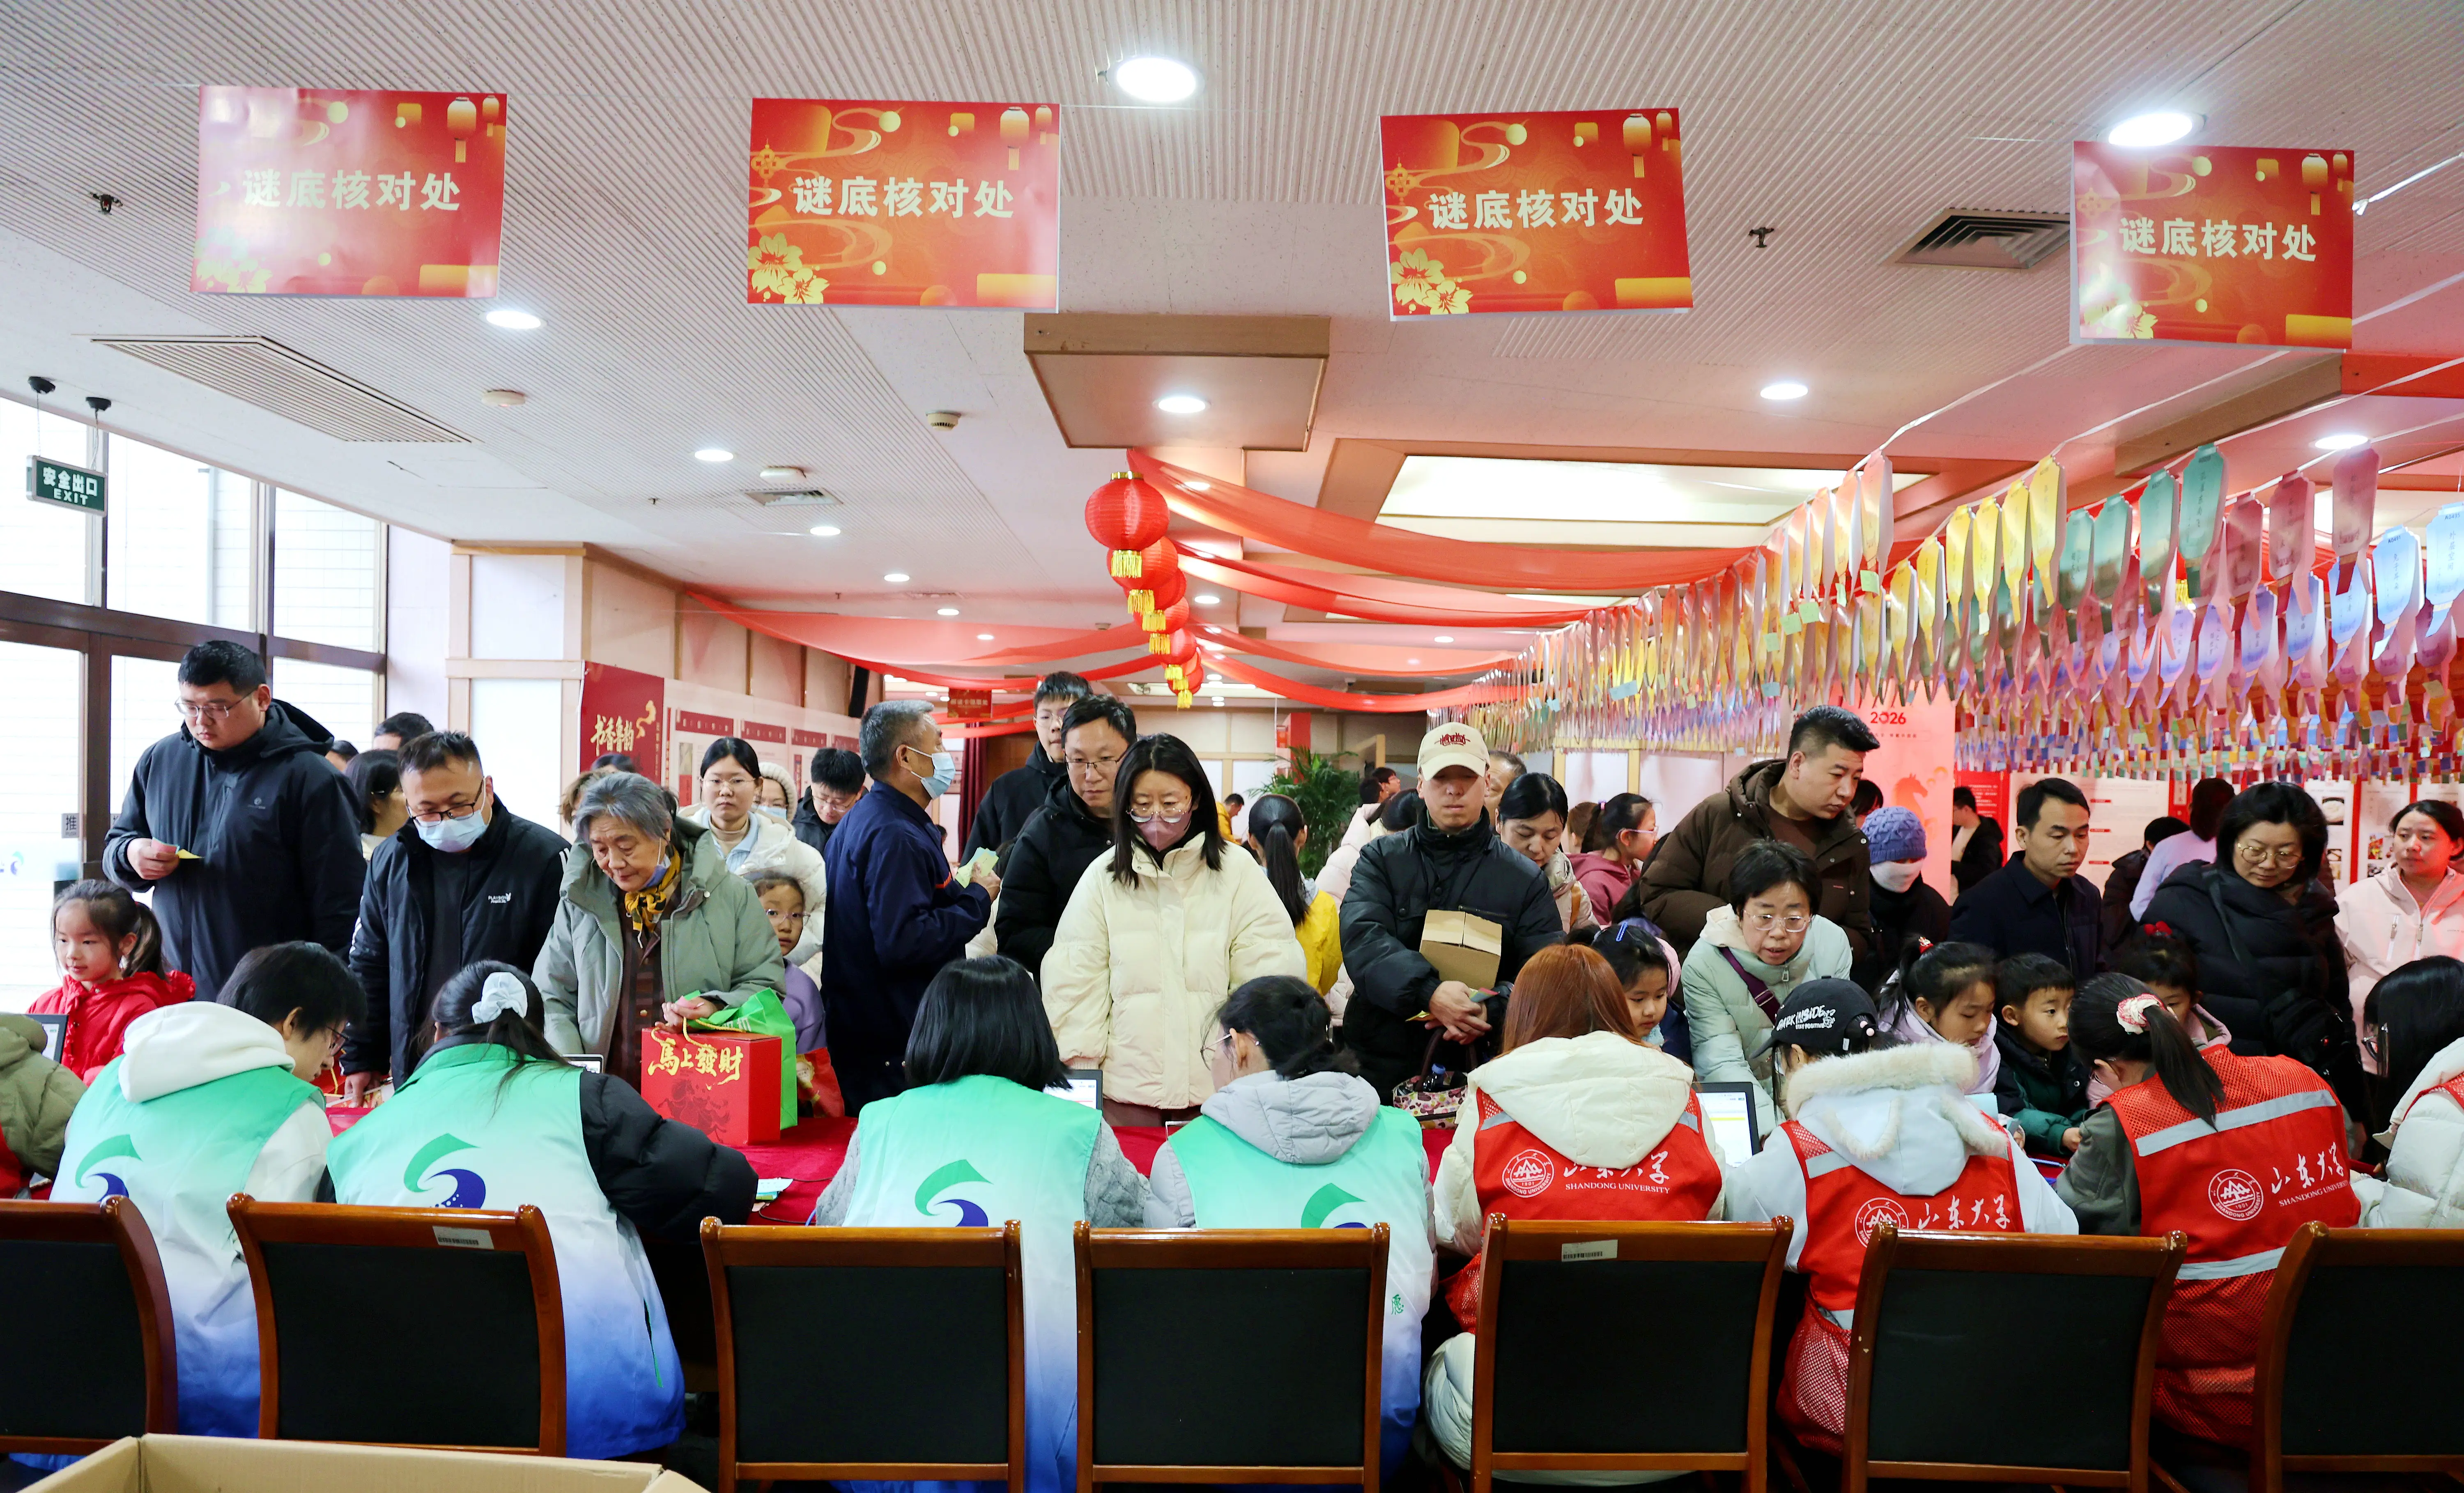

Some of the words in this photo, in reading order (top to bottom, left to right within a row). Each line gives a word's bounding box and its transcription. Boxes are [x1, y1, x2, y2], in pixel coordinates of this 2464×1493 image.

[242, 168, 460, 211] 谜底核对处
[793, 176, 1014, 218] 谜底核对处
[1429, 188, 1643, 230] 谜底核对处
[2119, 217, 2316, 262] 谜底核对处
[43, 467, 98, 497] 安全出口
[54, 488, 88, 505] EXIT
[1871, 711, 1906, 725] 2026
[66, 815, 77, 830] 推
[647, 1038, 744, 1087] 馬上發財
[2271, 1142, 2344, 1194] 山东大学
[1618, 1183, 1670, 1194] UNIVERSITY
[2279, 1189, 2323, 1207] SHANDONG
[1917, 1194, 2011, 1230] 山东大学
